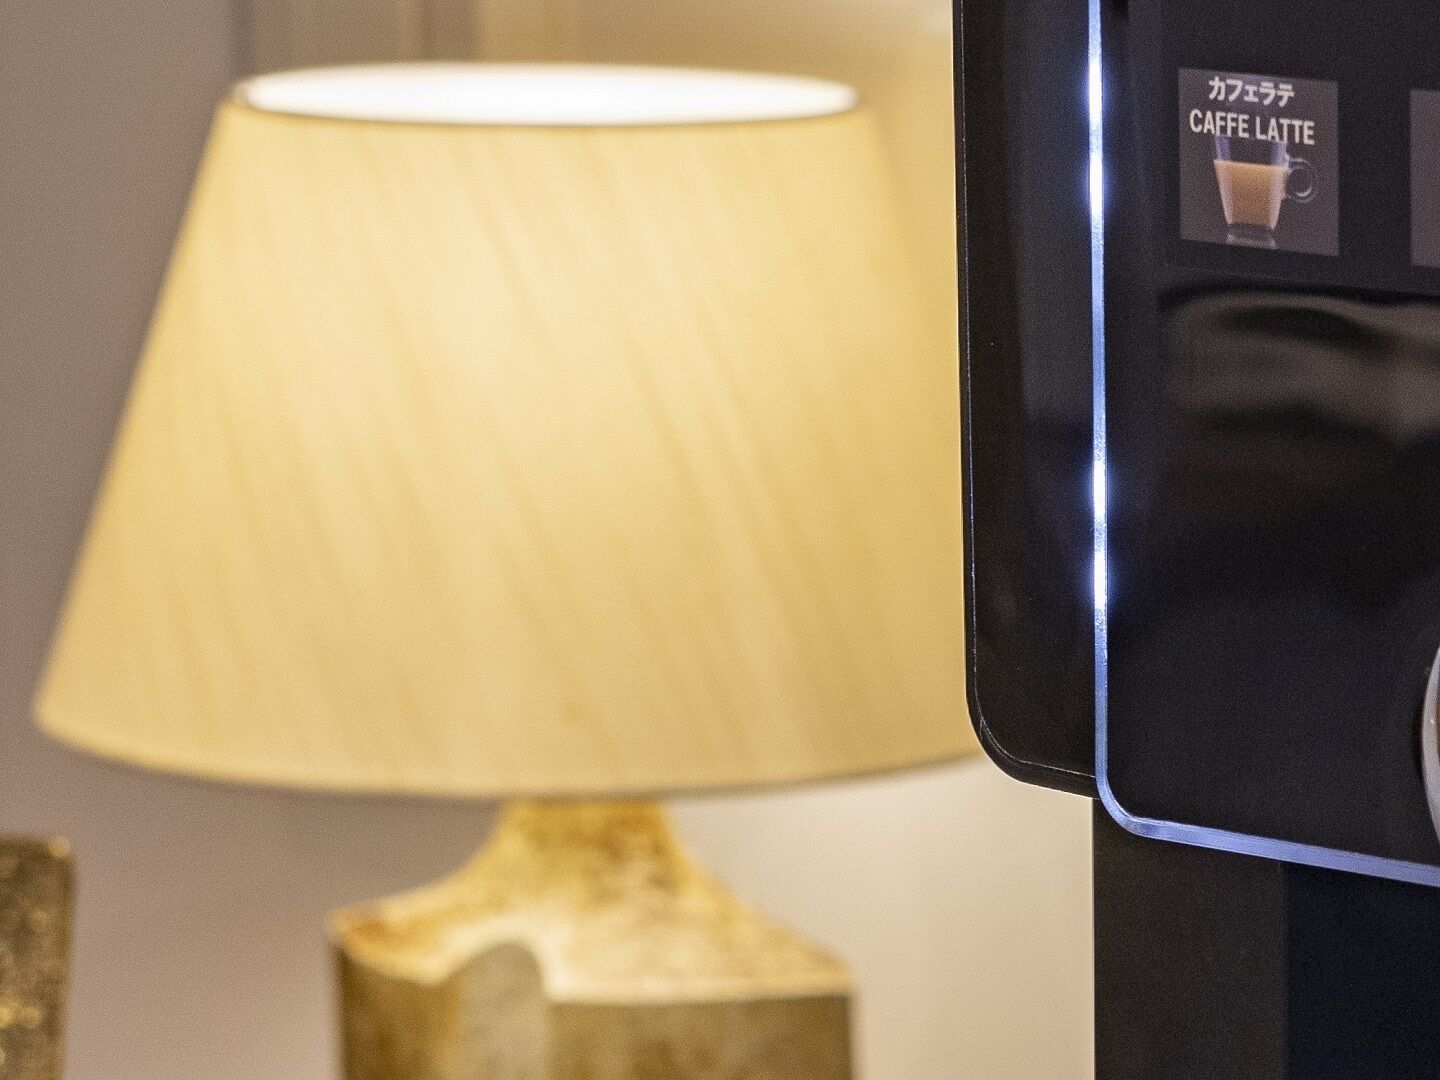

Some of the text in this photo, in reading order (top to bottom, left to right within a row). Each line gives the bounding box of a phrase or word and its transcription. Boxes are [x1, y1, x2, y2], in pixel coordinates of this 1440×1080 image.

[1208, 76, 1295, 107] カフェラテ
[1189, 108, 1315, 145] CAFFE LATTE
